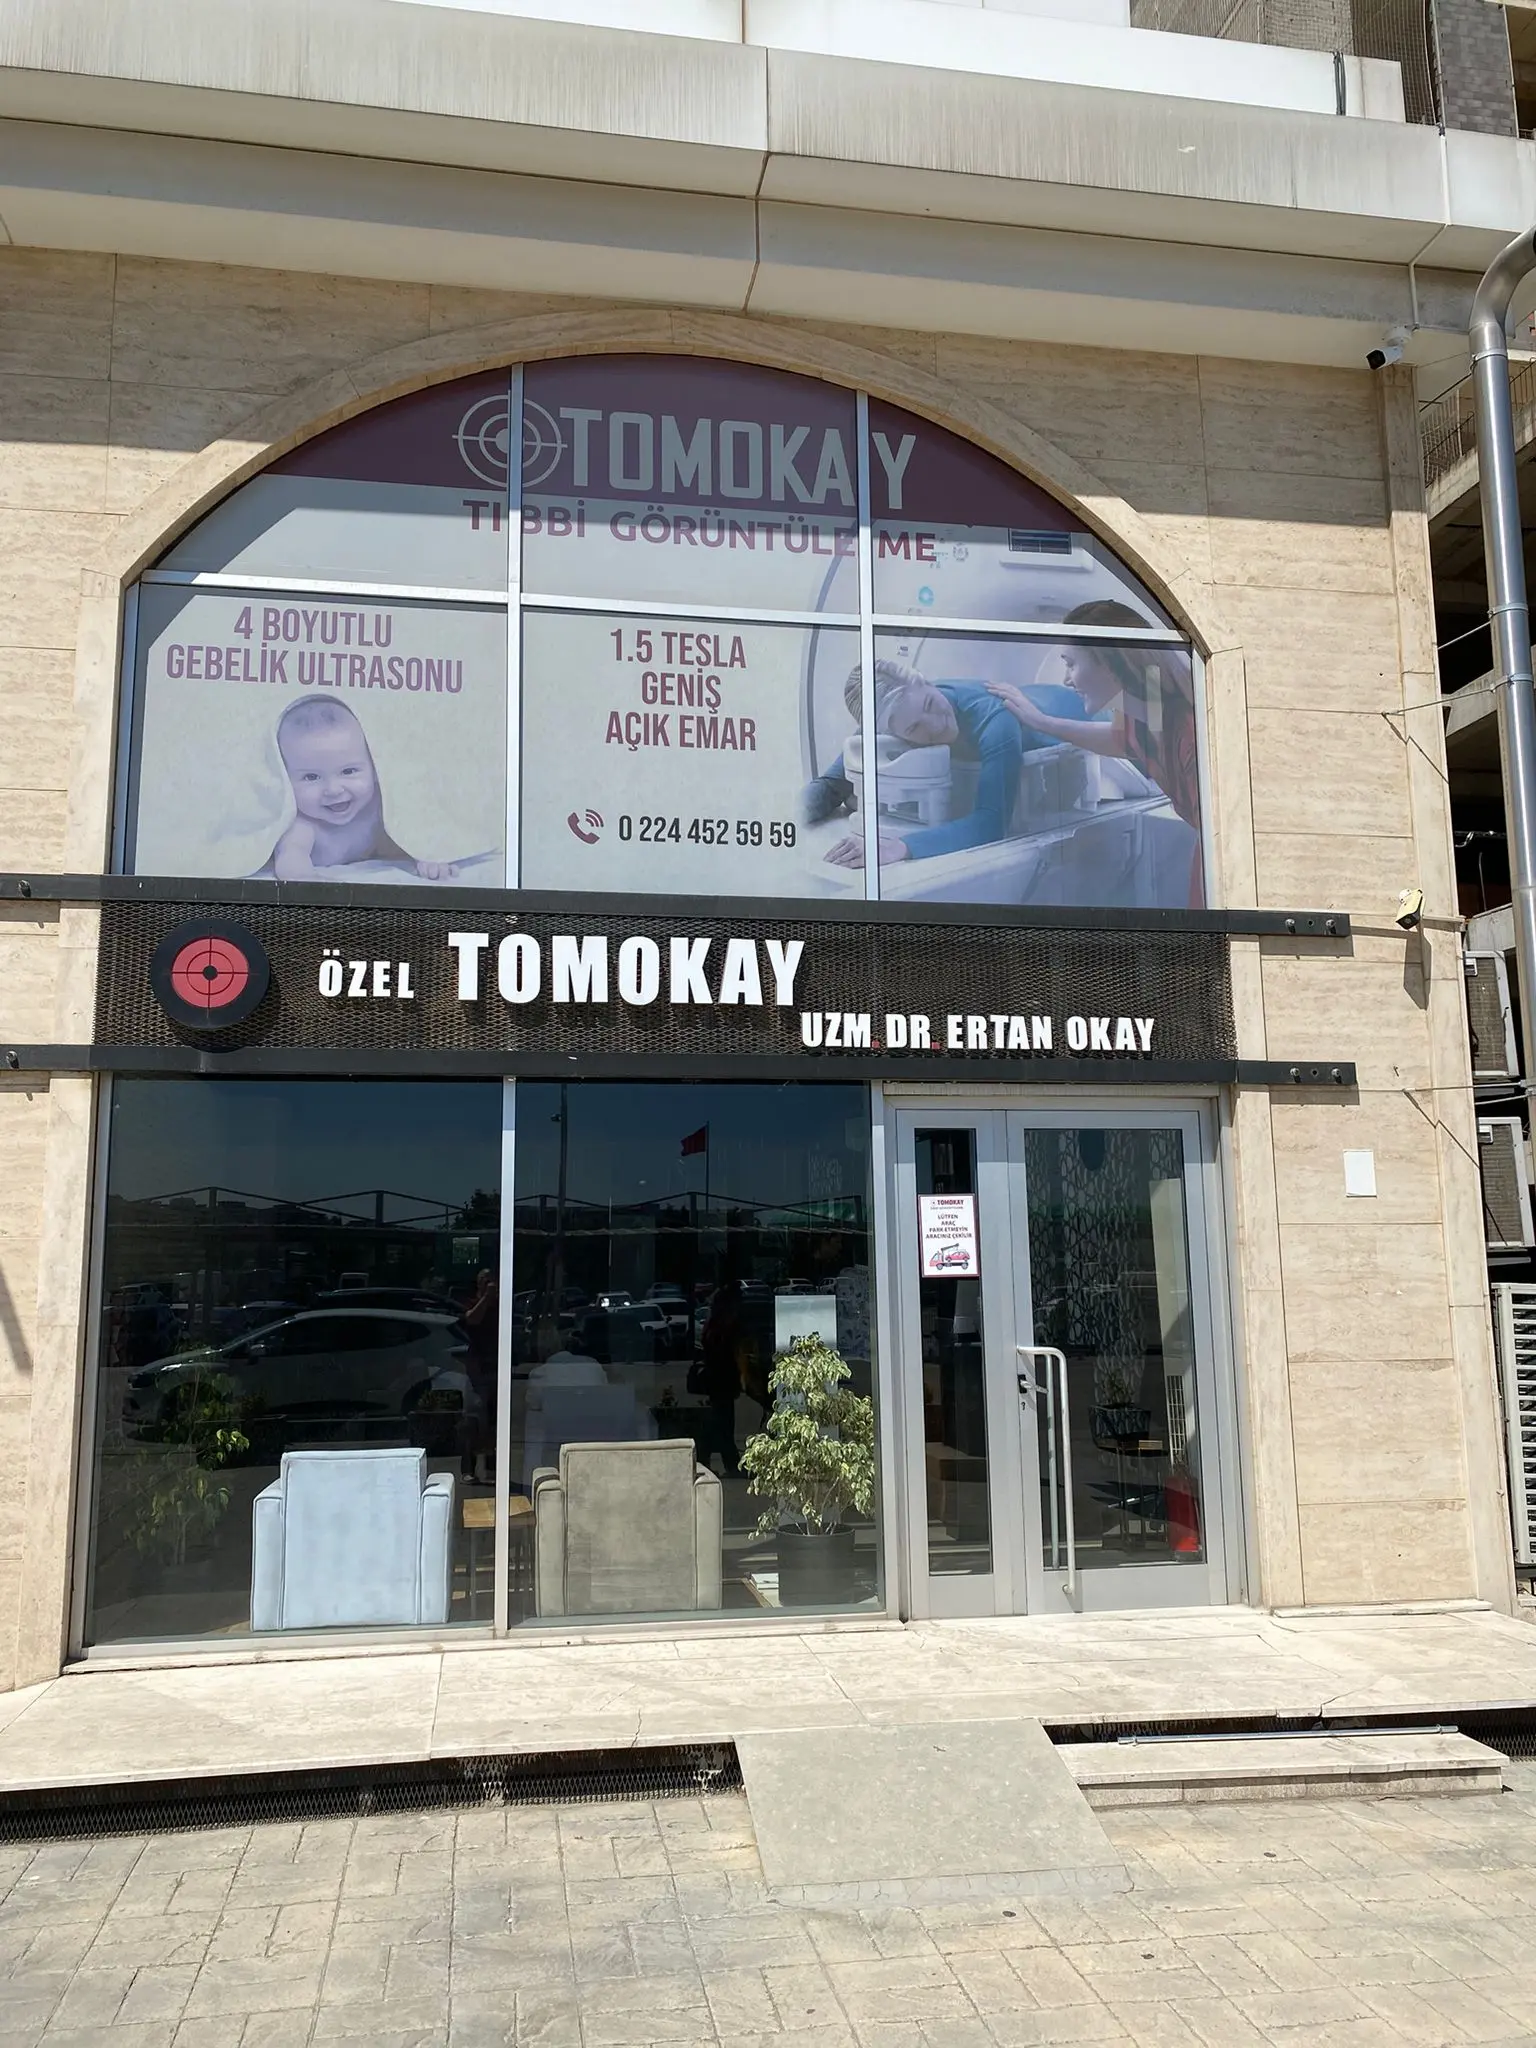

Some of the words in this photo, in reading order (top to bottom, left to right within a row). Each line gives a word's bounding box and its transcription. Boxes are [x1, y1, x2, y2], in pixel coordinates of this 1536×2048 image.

[559, 406, 916, 510] TOMOKAY
[233, 607, 254, 640] 4
[262, 608, 392, 648] BOYUTLU
[166, 642, 288, 686] GEBELİK
[298, 650, 463, 694] ULTRASONU
[610, 628, 654, 664] 1.5
[661, 631, 747, 669] TESLA
[641, 667, 722, 715] GENİŞ
[605, 711, 670, 752] AÇIK
[679, 715, 757, 752] EMAR
[618, 816, 632, 841] 0
[639, 817, 682, 844] 224
[687, 819, 730, 846] 452
[735, 820, 764, 848] 59
[769, 822, 798, 849] 59
[318, 949, 415, 999] ÖZEL
[447, 932, 805, 1007] TOMOKAY
[947, 1014, 1053, 1050] ERTAN
[1067, 1016, 1155, 1052] OKAY
